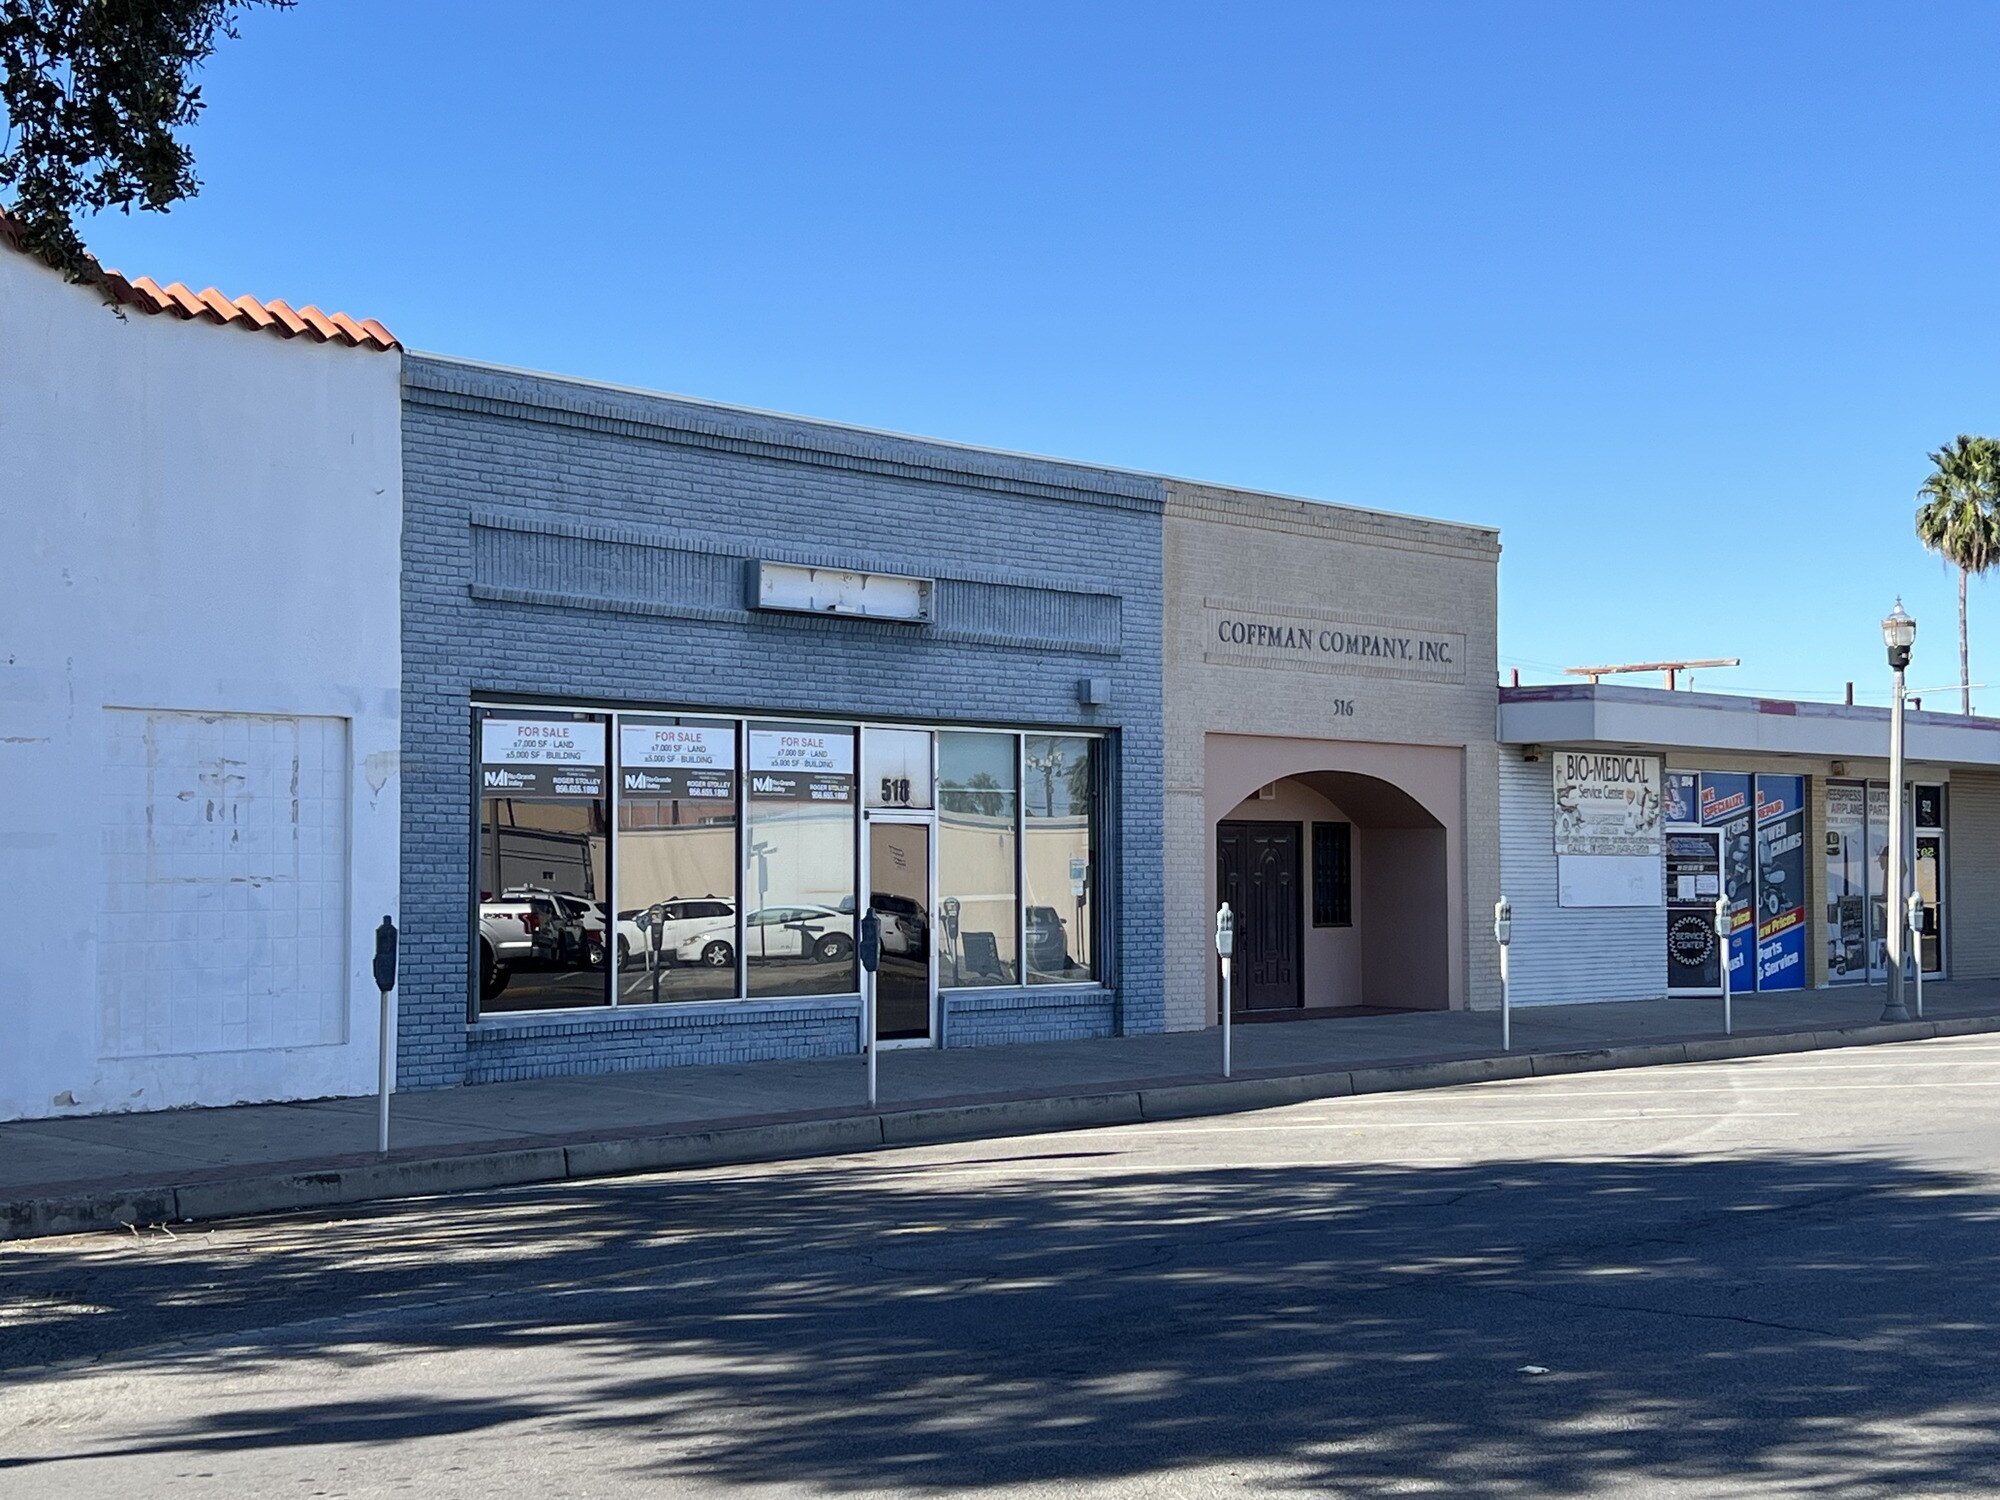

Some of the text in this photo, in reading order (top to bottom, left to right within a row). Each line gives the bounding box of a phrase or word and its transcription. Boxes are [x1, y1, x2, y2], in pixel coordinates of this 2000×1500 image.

[1218, 620, 1453, 664] COFFMAN COMPANY, INC.
[1333, 699, 1354, 716] 516
[518, 726, 569, 738] FOR SALE
[655, 731, 702, 742] FOR SALE
[538, 740, 548, 748] SF
[553, 741, 575, 749] LAND
[687, 745, 706, 753] LAND
[781, 737, 824, 748] FOR SALE
[530, 751, 540, 759] SF
[546, 751, 581, 760] BUILDING
[681, 756, 713, 764] BUILDING
[810, 750, 828, 758] LAND
[804, 760, 833, 768] BUILDING
[1567, 755, 1648, 783] BIO-MEDICAL
[484, 768, 508, 787] NAI
[625, 772, 646, 789] NAI
[753, 775, 773, 792] NAI
[881, 778, 910, 804] 518
[1578, 784, 1625, 800] Service Center
[1702, 788, 1713, 803] WE
[1703, 793, 1744, 819] SPECIALIZE
[1831, 803, 1863, 815] AIRPLANE
[1771, 913, 1797, 933] Prices
[1674, 932, 1705, 940] SERVICE
[1677, 941, 1705, 949] CENTER
[1764, 951, 1799, 977] Service
